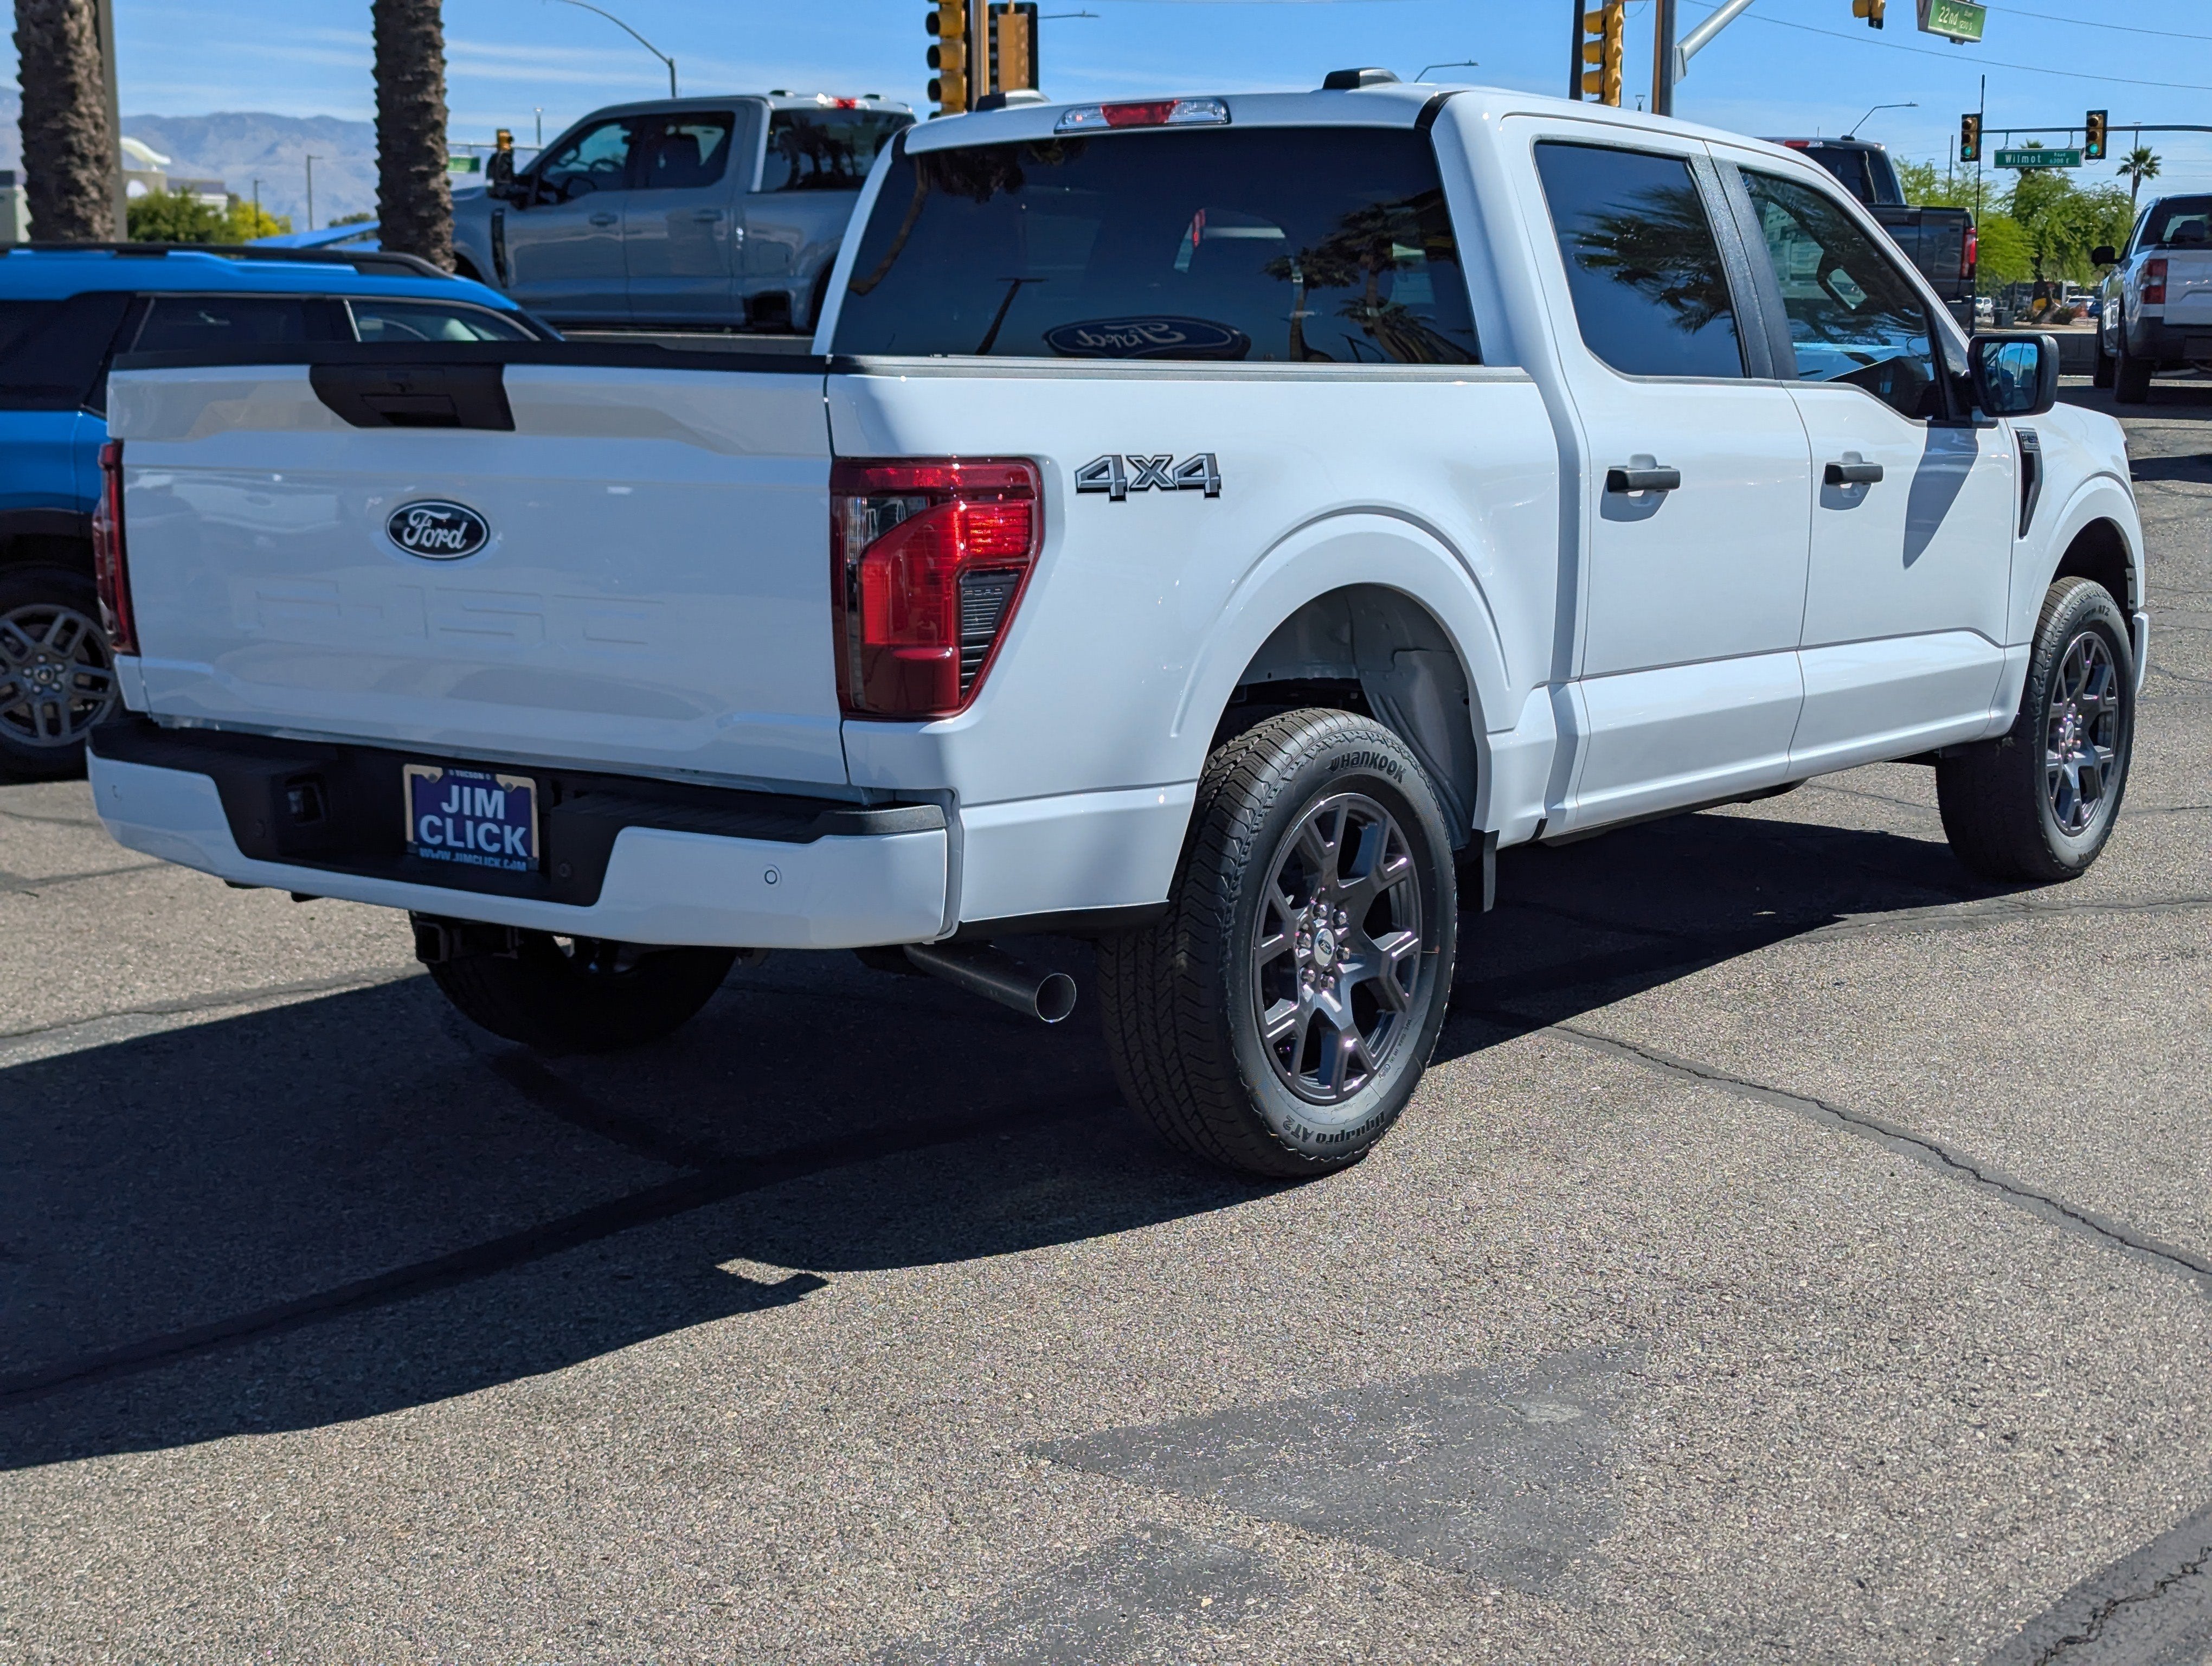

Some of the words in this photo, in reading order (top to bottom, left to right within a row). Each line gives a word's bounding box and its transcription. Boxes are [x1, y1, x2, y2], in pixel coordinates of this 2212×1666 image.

[1938, 5, 1959, 25] 22nd
[2005, 153, 2041, 163] Wilmot
[403, 509, 469, 549] Ford
[441, 784, 505, 820] JIM
[419, 814, 528, 857] CLICK
